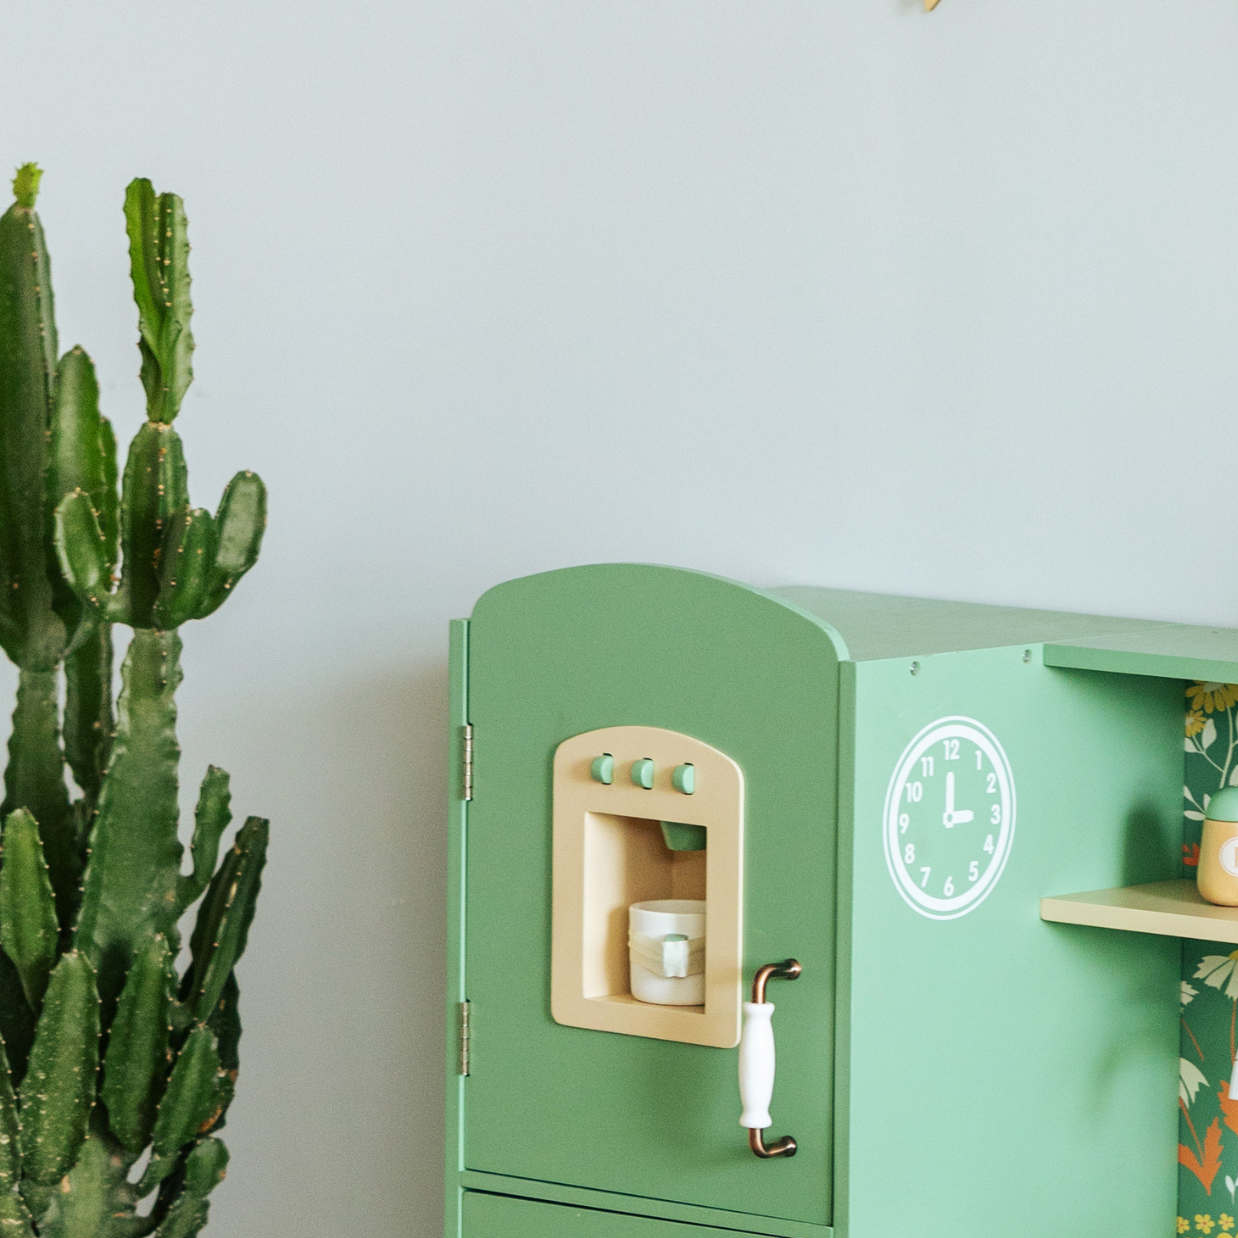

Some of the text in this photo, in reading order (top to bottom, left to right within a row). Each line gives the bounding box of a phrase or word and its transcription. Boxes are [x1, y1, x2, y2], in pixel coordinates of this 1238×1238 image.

[943, 739, 960, 760] 12
[975, 750, 982, 770] 1
[921, 756, 934, 777] 11
[906, 781, 922, 802] 10
[986, 772, 996, 793] 2
[899, 813, 910, 834] 9
[990, 804, 1000, 825] 3
[904, 843, 915, 864] 8
[983, 834, 994, 854] 4
[920, 867, 931, 887] 7
[968, 861, 979, 881] 5
[943, 876, 954, 896] 6
